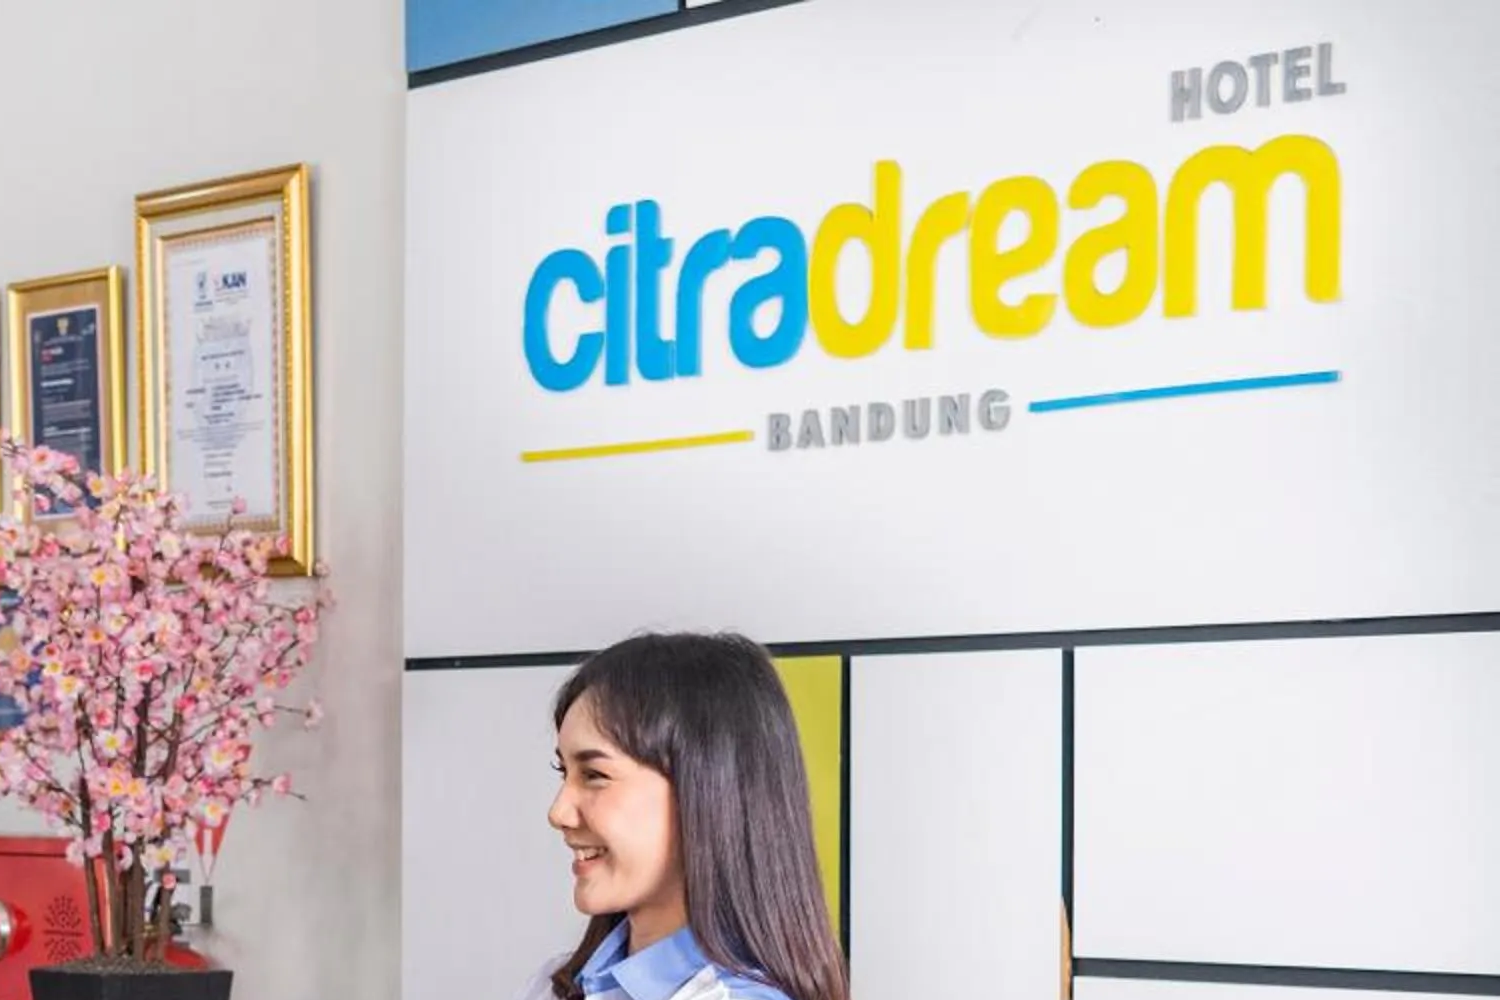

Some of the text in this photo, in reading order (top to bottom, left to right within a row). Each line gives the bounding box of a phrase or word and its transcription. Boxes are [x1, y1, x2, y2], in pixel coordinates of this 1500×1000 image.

[1170, 42, 1347, 122] HOTEL
[523, 133, 1344, 393] citradream
[767, 389, 1012, 452] BANDUNG
